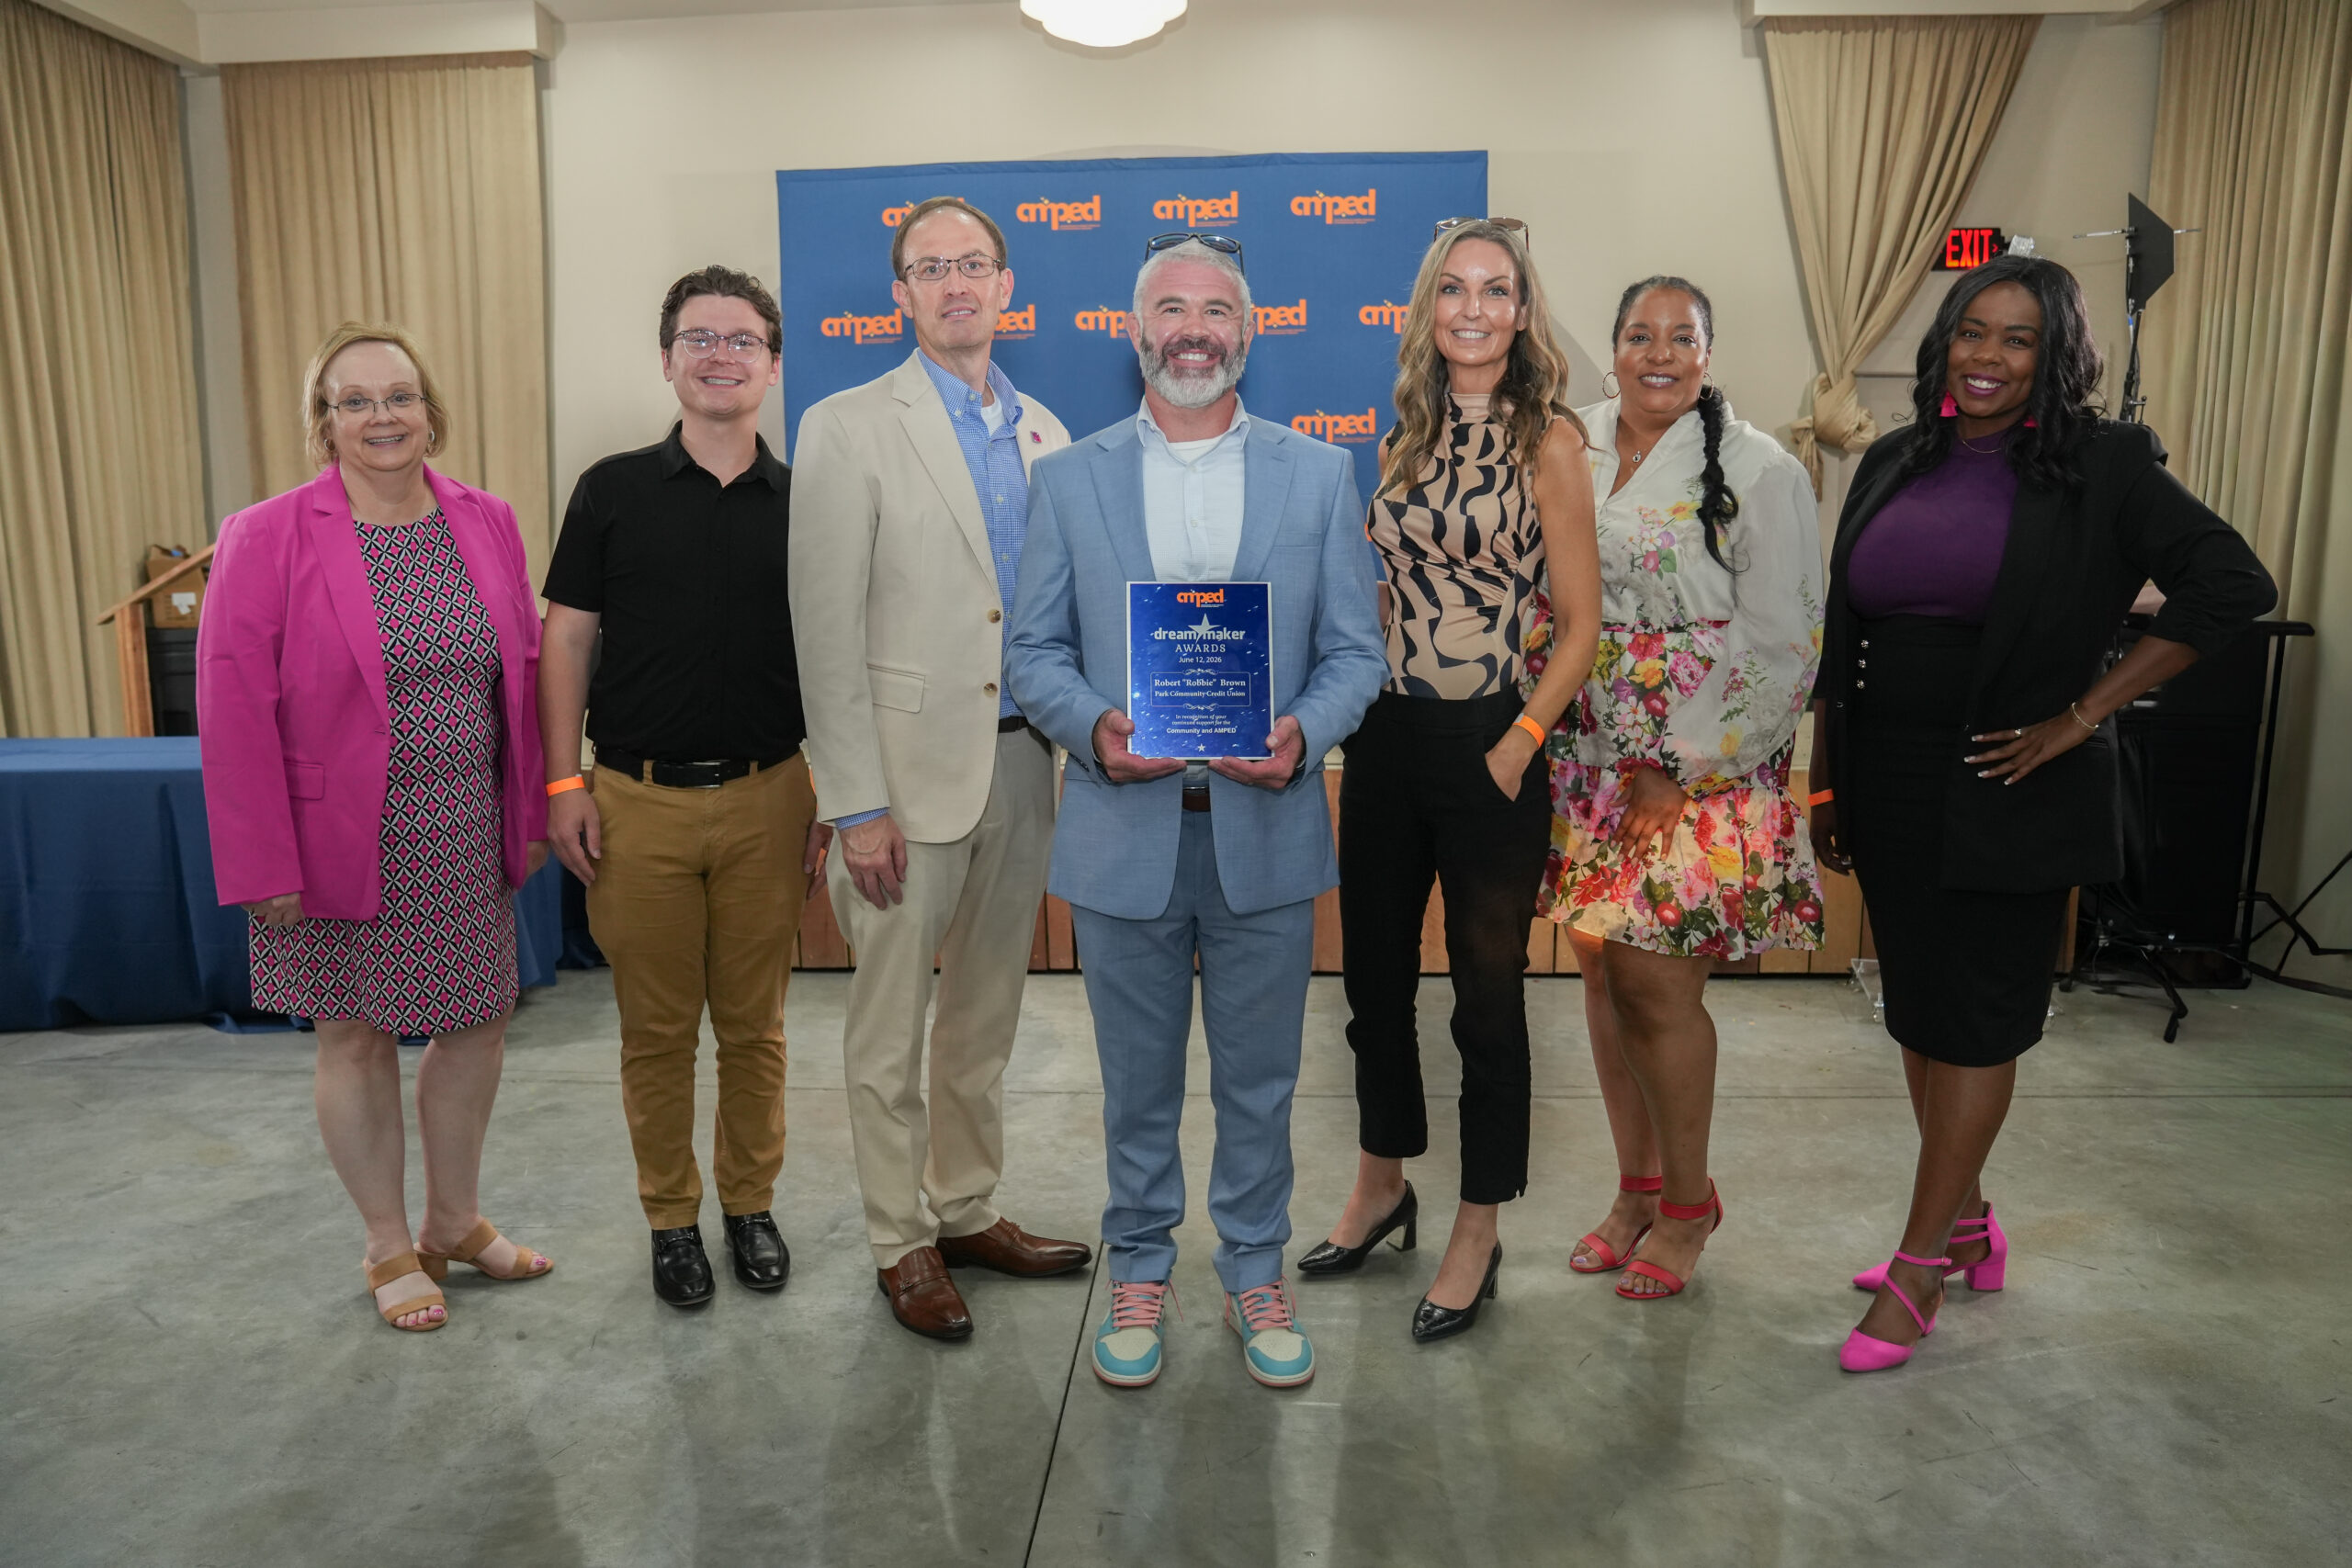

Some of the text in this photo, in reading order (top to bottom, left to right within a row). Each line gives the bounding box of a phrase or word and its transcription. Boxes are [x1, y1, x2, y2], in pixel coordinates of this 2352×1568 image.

[1015, 195, 1101, 231] amped
[1152, 191, 1238, 227] amped
[1290, 188, 1376, 224] amped
[1946, 229, 1993, 267] EXIT
[820, 309, 903, 344] amped
[991, 304, 1035, 340] ped
[1075, 310, 1127, 338] amp
[1359, 305, 1409, 333] amp
[1291, 408, 1375, 443] amped
[1177, 588, 1224, 607] amped
[1154, 626, 1246, 640] dream maker
[1175, 644, 1226, 653] AWARDS
[1154, 679, 1246, 687] Robert "Robbie" Brown
[1170, 690, 1205, 698] Community
